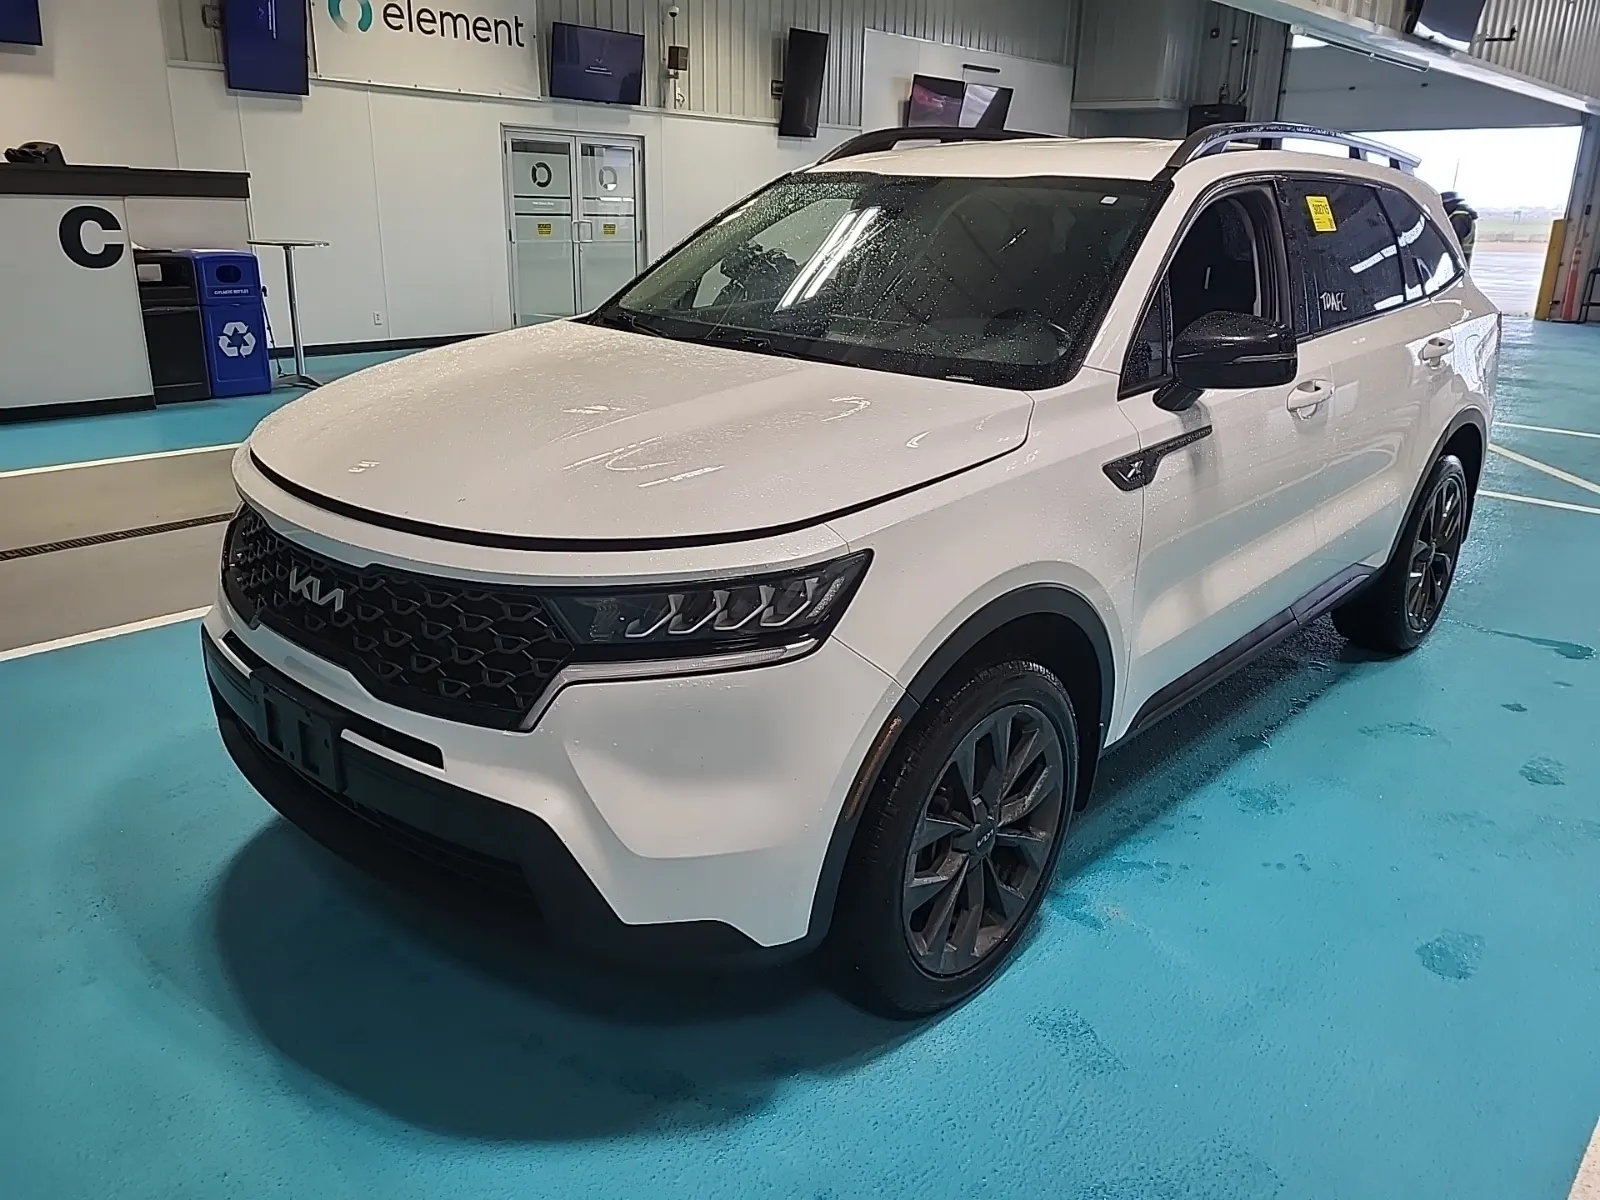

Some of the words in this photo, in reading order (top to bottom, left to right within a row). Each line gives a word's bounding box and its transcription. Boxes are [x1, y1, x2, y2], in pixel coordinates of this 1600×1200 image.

[383, 0, 525, 48] element
[58, 205, 125, 269] C
[289, 567, 345, 613] KIA
